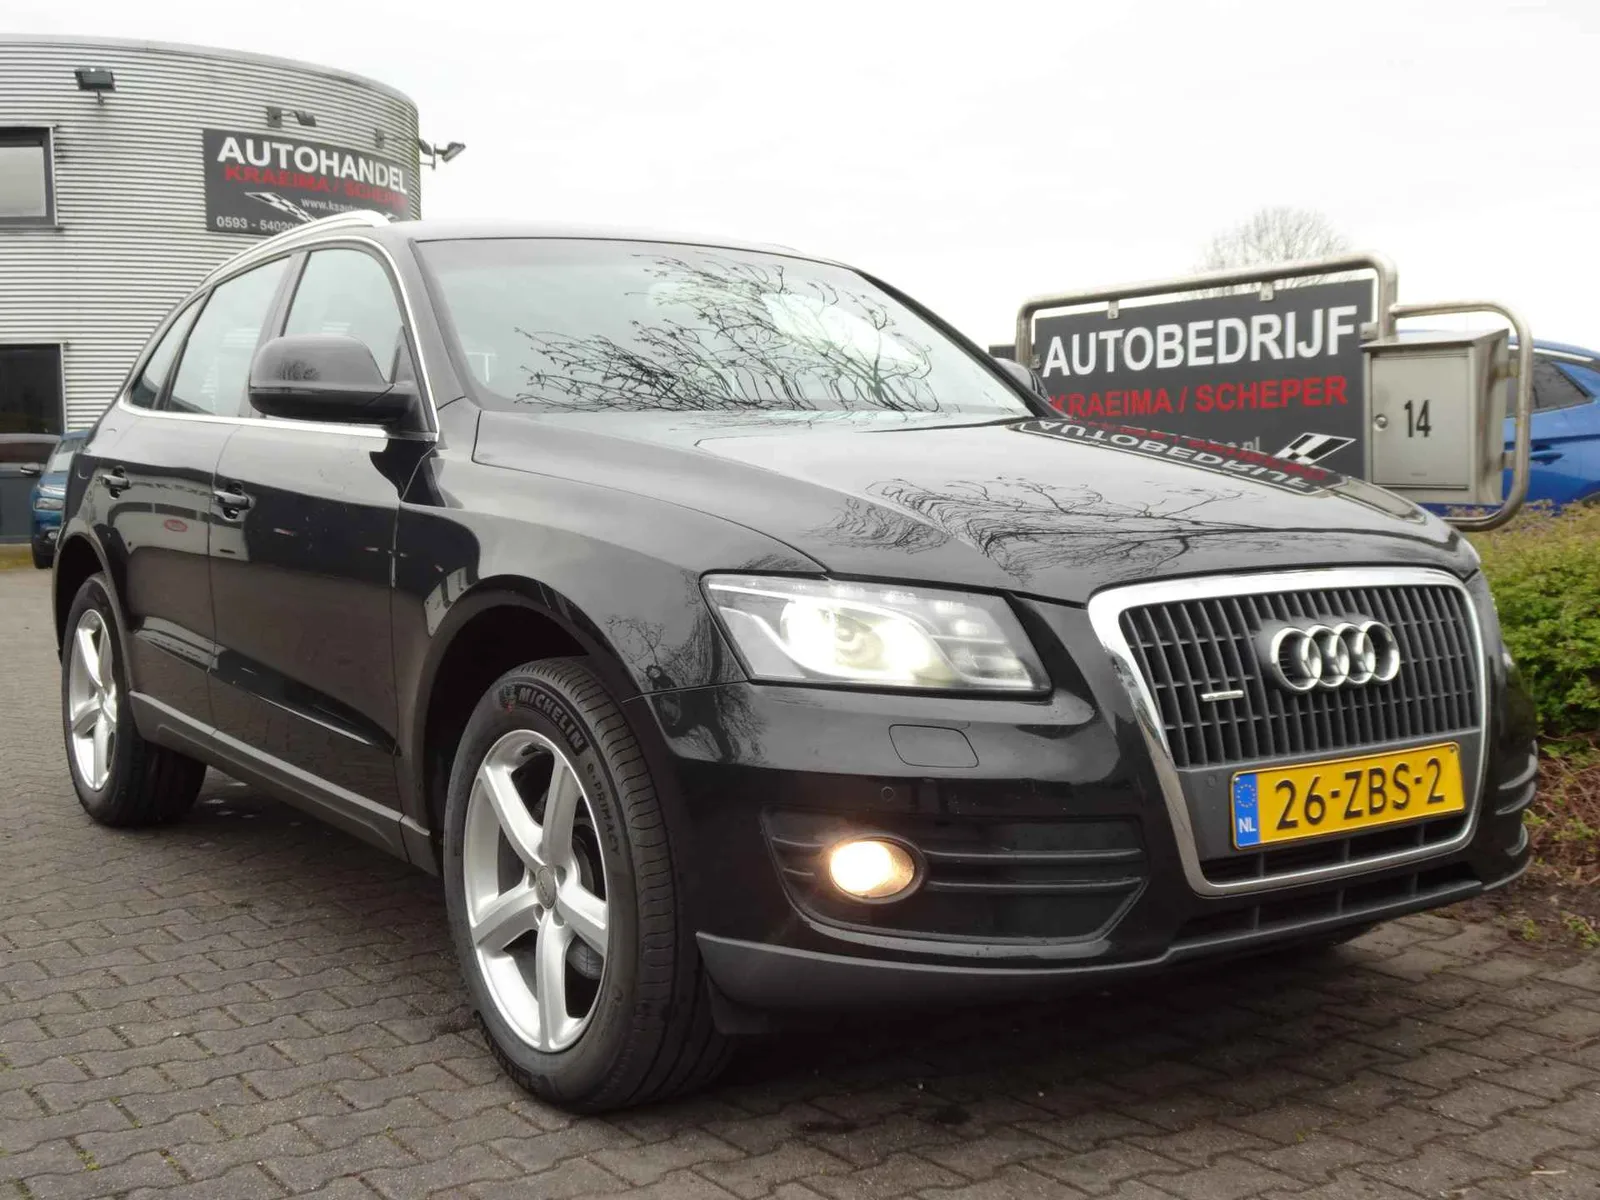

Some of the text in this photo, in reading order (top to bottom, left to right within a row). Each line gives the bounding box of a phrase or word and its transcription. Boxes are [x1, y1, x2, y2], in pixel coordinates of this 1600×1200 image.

[217, 137, 408, 194] AUTOHANDEL
[224, 164, 331, 193] KRAEIMA
[216, 216, 248, 229] 0593
[1042, 305, 1357, 378] AUTOBEDRIJF
[1050, 375, 1349, 418] KRAEIMA / SCHEPER
[1404, 399, 1432, 438] 14
[519, 687, 584, 749] MICHELIN
[1275, 757, 1446, 830] 26-ZBS-2
[1238, 817, 1257, 832] NL
